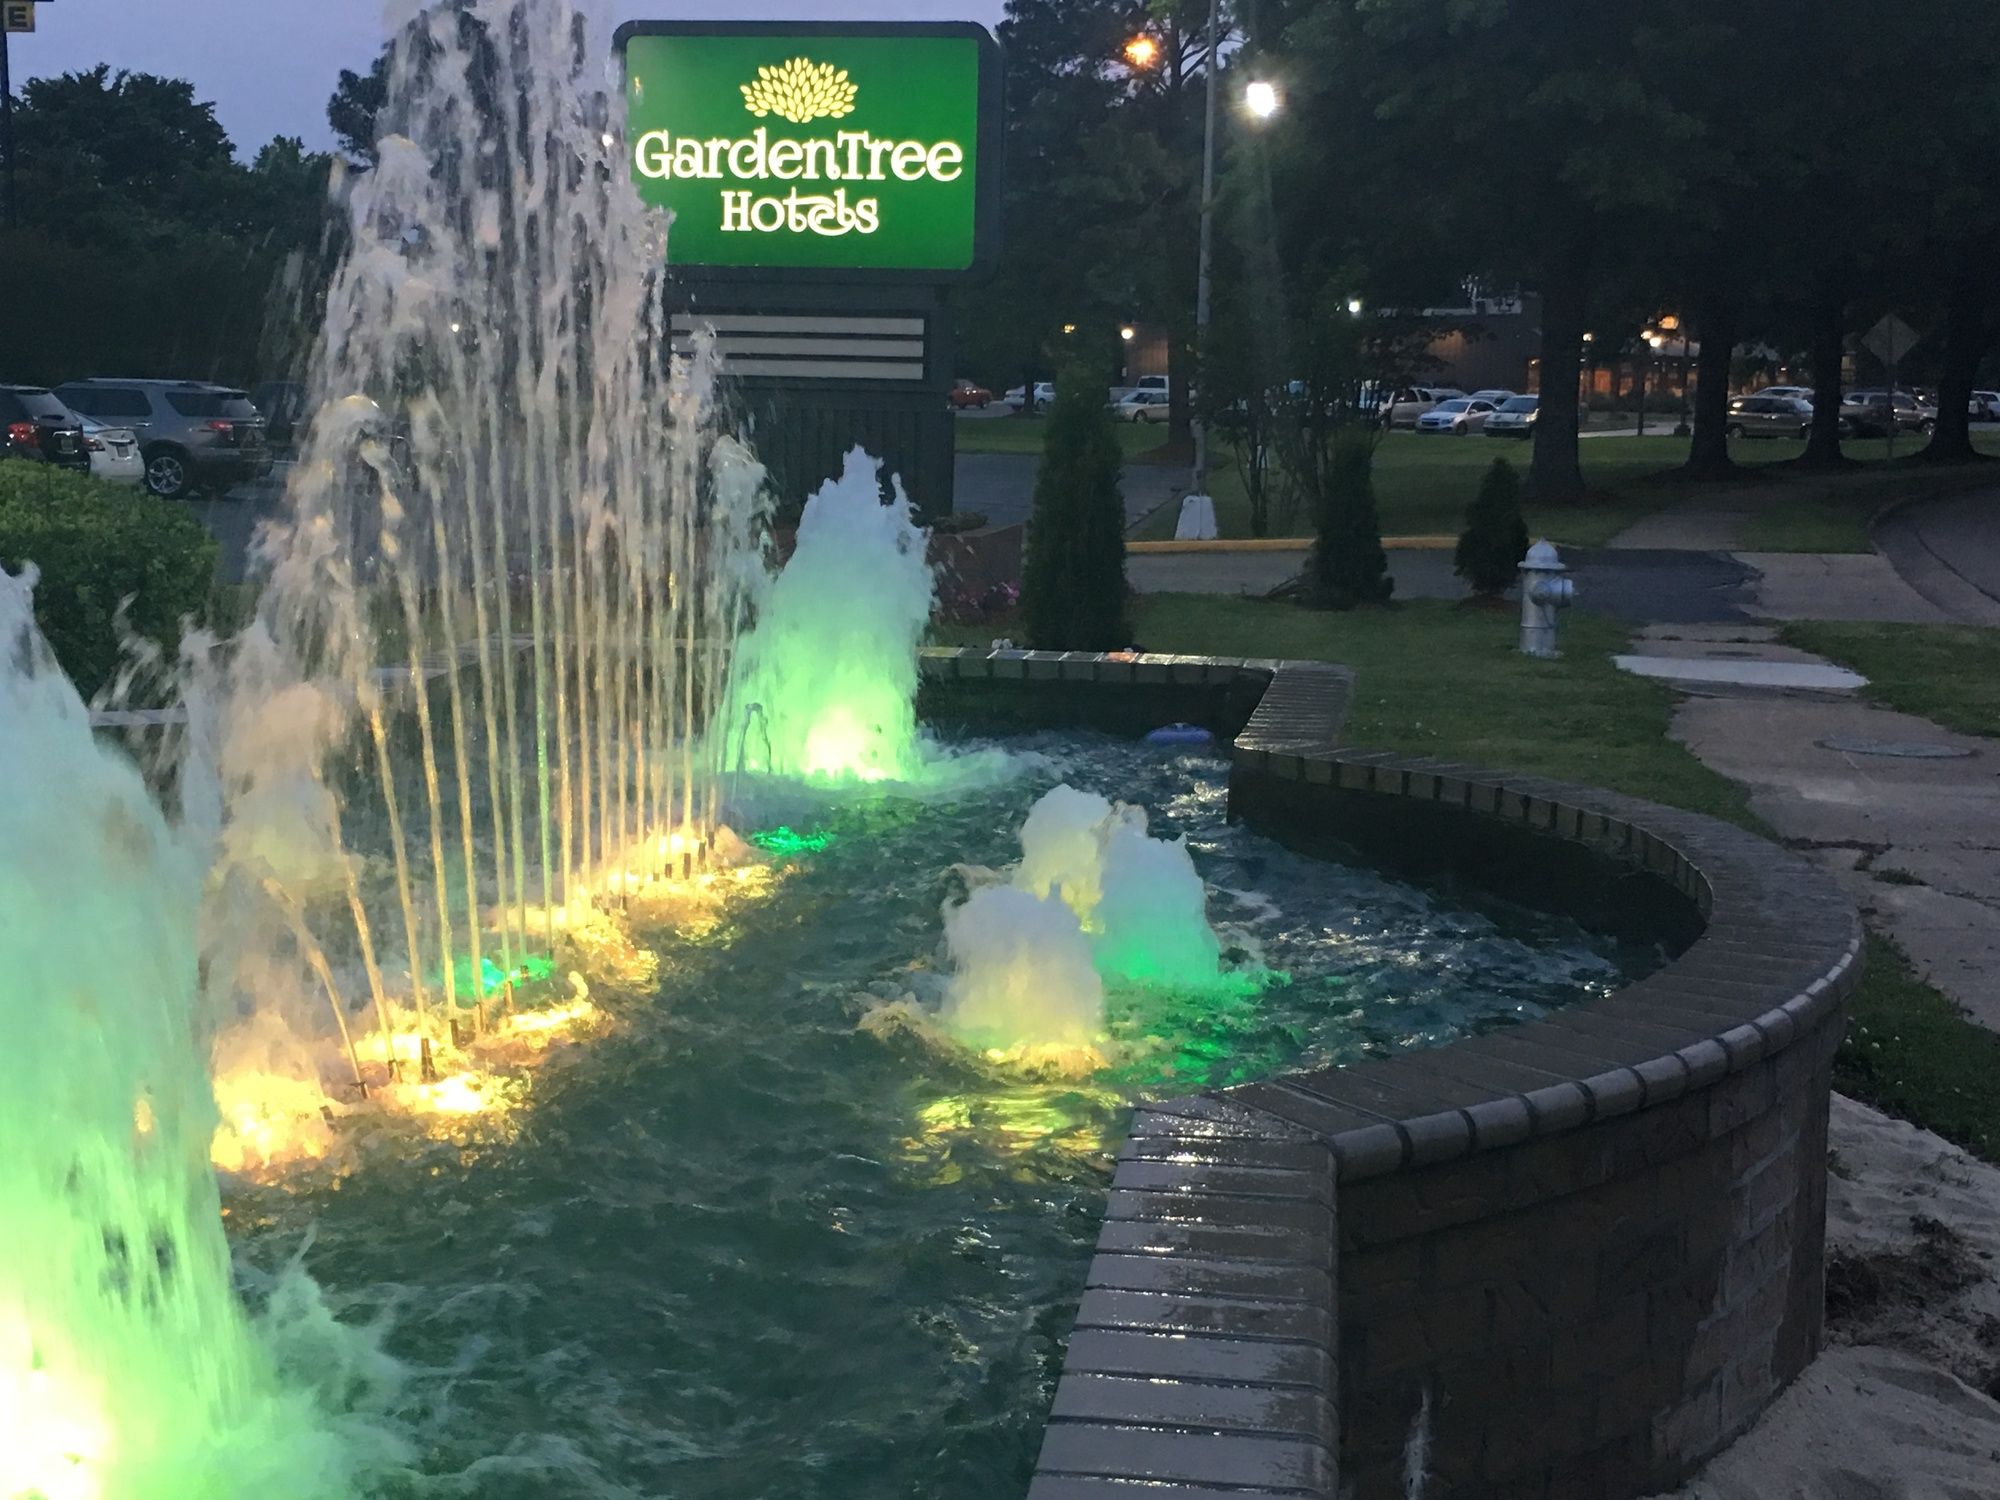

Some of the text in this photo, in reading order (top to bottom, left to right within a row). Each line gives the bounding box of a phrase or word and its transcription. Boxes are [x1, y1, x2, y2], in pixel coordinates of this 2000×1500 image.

[8, 6, 28, 27] E
[635, 126, 963, 182] GardenTree
[720, 186, 879, 236] Hotels
